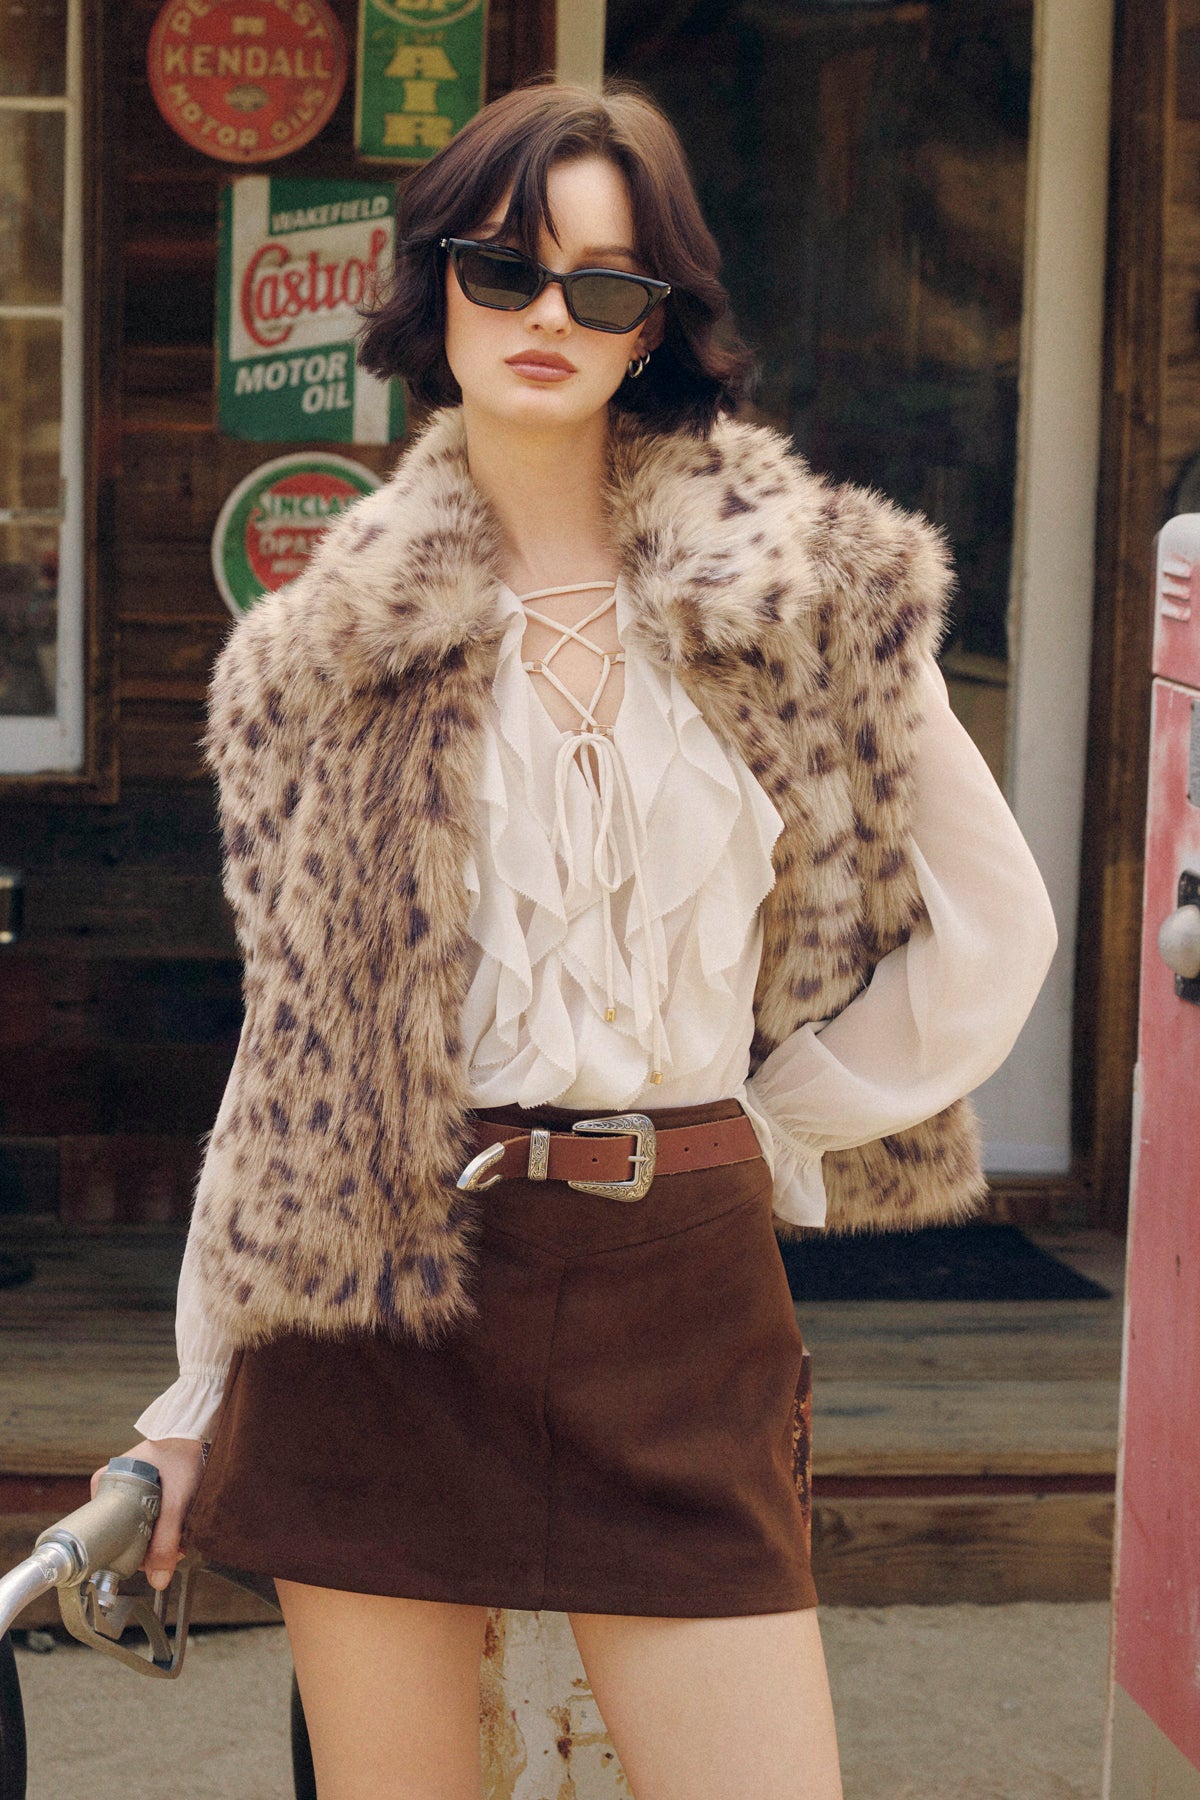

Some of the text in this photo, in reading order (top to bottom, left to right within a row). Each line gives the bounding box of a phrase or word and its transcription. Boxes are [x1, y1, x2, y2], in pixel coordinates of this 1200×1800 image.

[164, 44, 331, 79] KENDALL
[167, 82, 326, 148] MOTOR OILS
[385, 46, 458, 147] AIR
[271, 196, 389, 233] WAKEFIELD
[241, 228, 388, 347] Castrol
[234, 352, 347, 395] MOTOR
[302, 382, 350, 414] OIL
[253, 488, 354, 523] SINCLA
